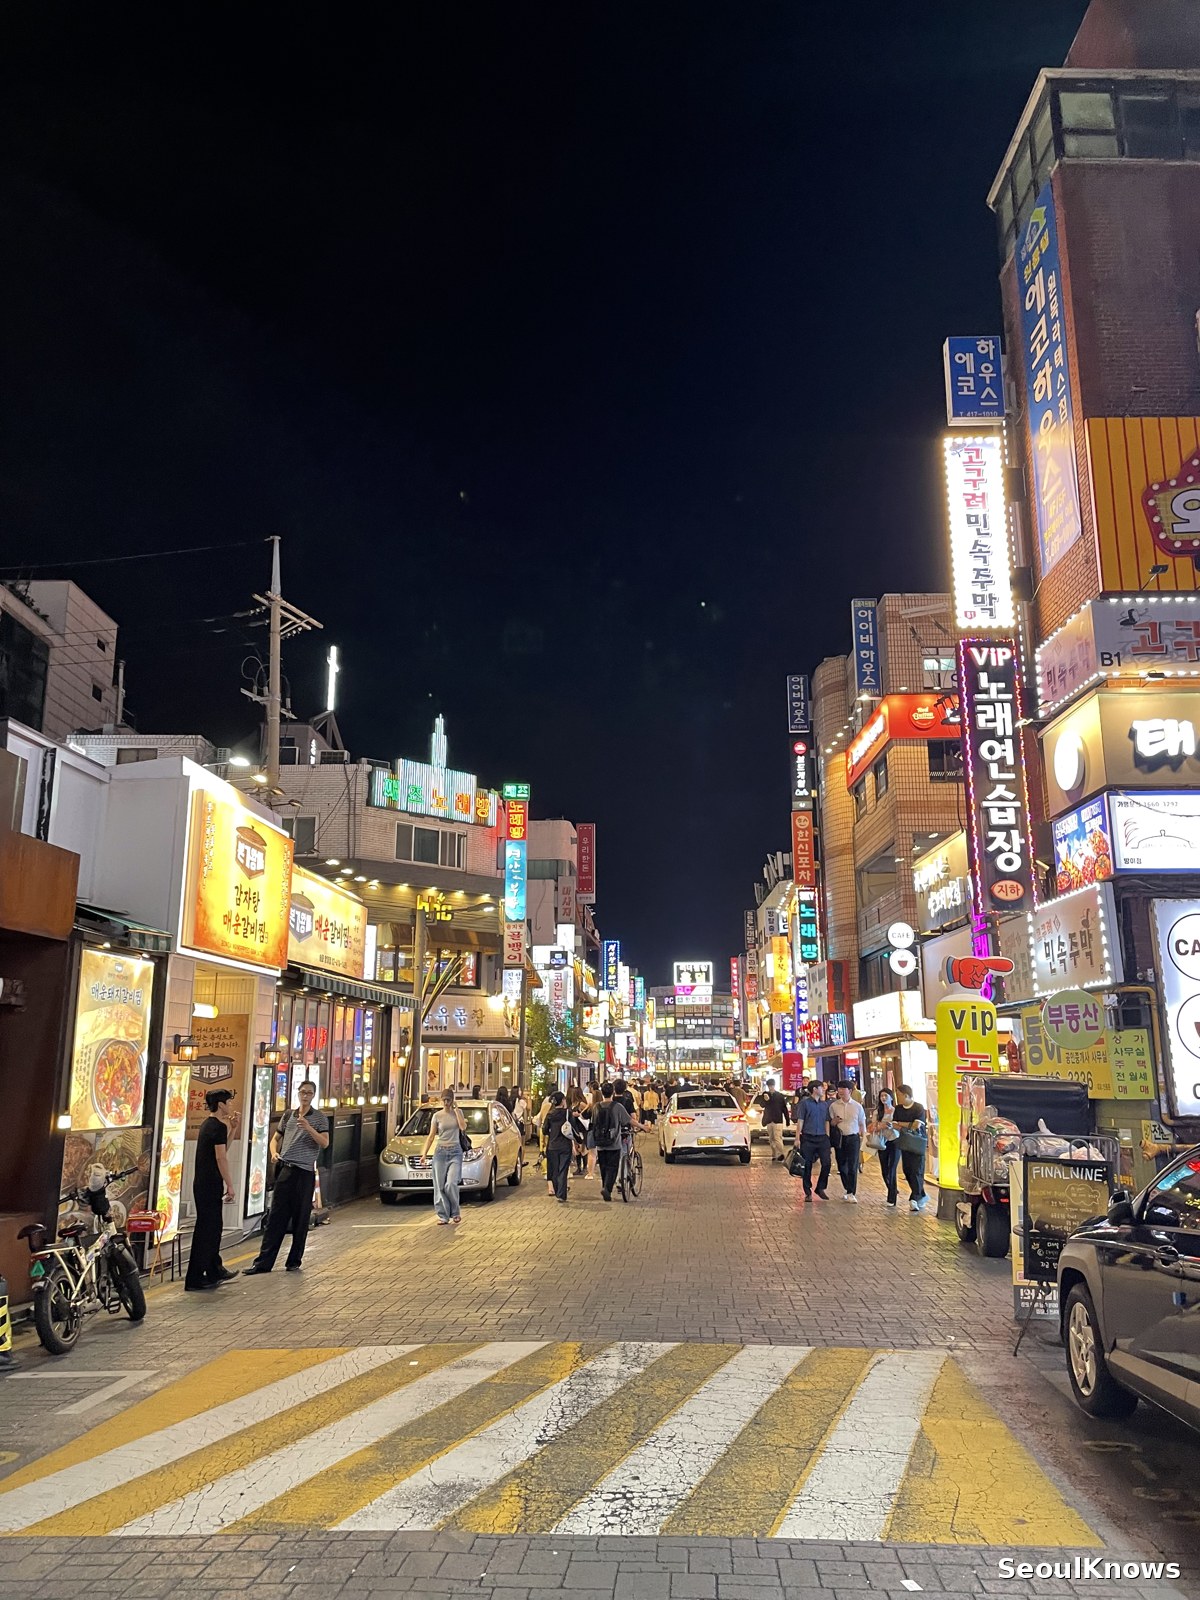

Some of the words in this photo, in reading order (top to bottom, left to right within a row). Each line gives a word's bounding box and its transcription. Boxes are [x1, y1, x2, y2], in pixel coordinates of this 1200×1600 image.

[954, 352, 976, 396] 에코
[976, 339, 999, 406] 하우스
[857, 609, 874, 647] 아이비
[860, 649, 876, 685] 하우스
[1101, 652, 1122, 667] B1
[791, 676, 805, 700] 아이비
[792, 701, 805, 723] 하우스
[974, 671, 1025, 873] 노래연습장
[508, 801, 525, 839] 노래방
[797, 829, 811, 882] 한신포차
[234, 883, 260, 914] 감자탕
[996, 881, 1021, 897] 지하
[223, 908, 266, 944] 매운갈비찜
[315, 913, 350, 949] 매운갈비찜
[800, 903, 818, 959] 노래방
[1043, 928, 1094, 976] 민속주막
[664, 996, 674, 1005] PC
[950, 1005, 994, 1036] vip
[1047, 1002, 1099, 1034] 부동산
[1065, 1051, 1090, 1064] 공인중개사
[1091, 1050, 1108, 1064] 사무실
[1113, 1048, 1145, 1057] 사무실
